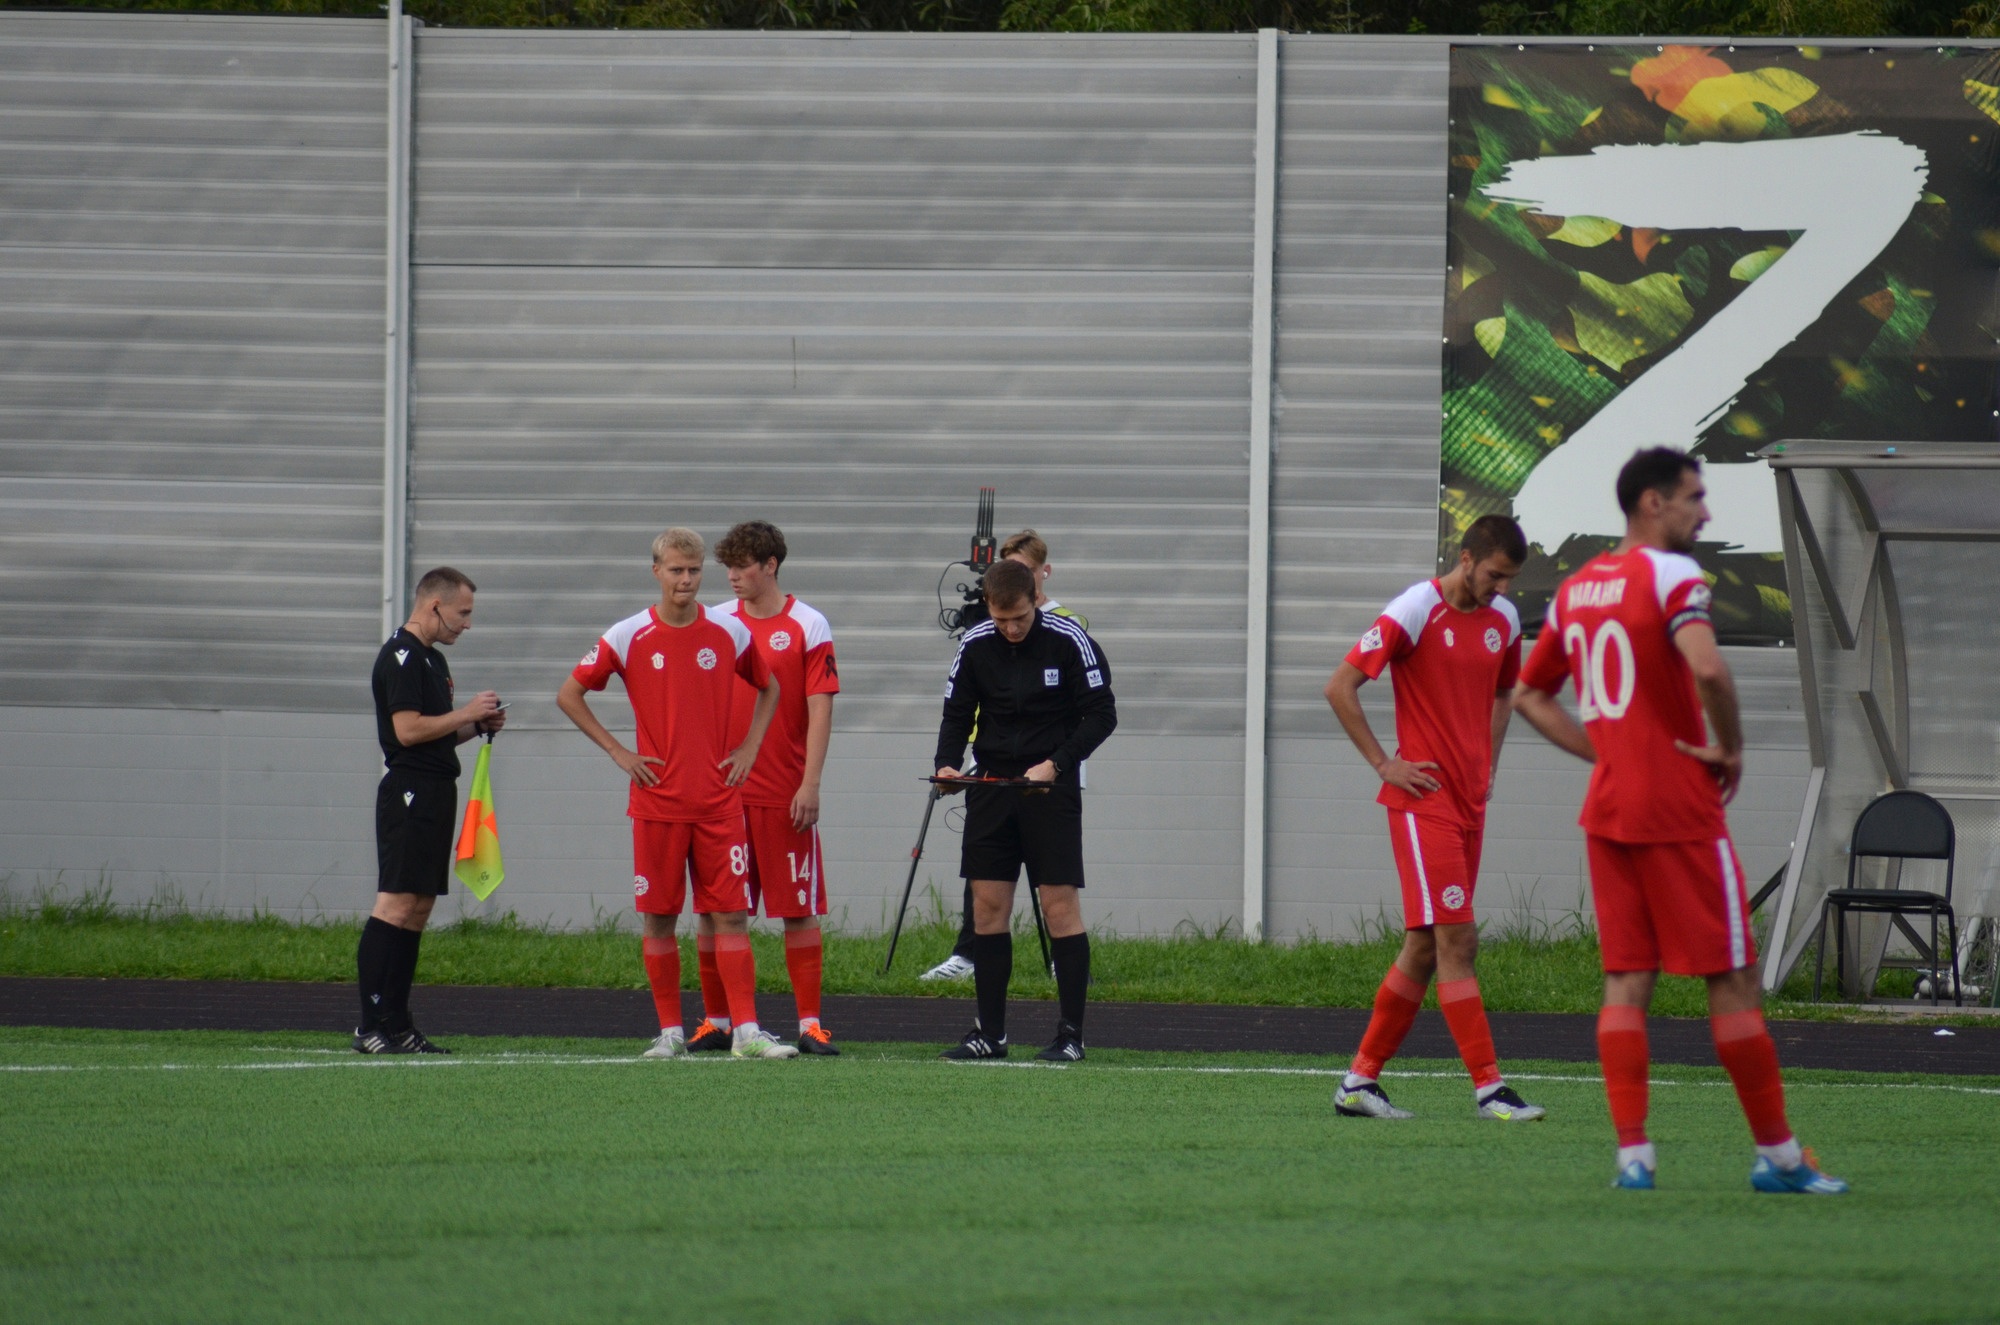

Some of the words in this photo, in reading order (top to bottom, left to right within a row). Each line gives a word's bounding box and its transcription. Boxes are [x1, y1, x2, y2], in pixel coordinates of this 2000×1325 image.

[1478, 129, 1929, 556] Z
[1564, 619, 1635, 723] 20
[787, 852, 811, 883] 14
